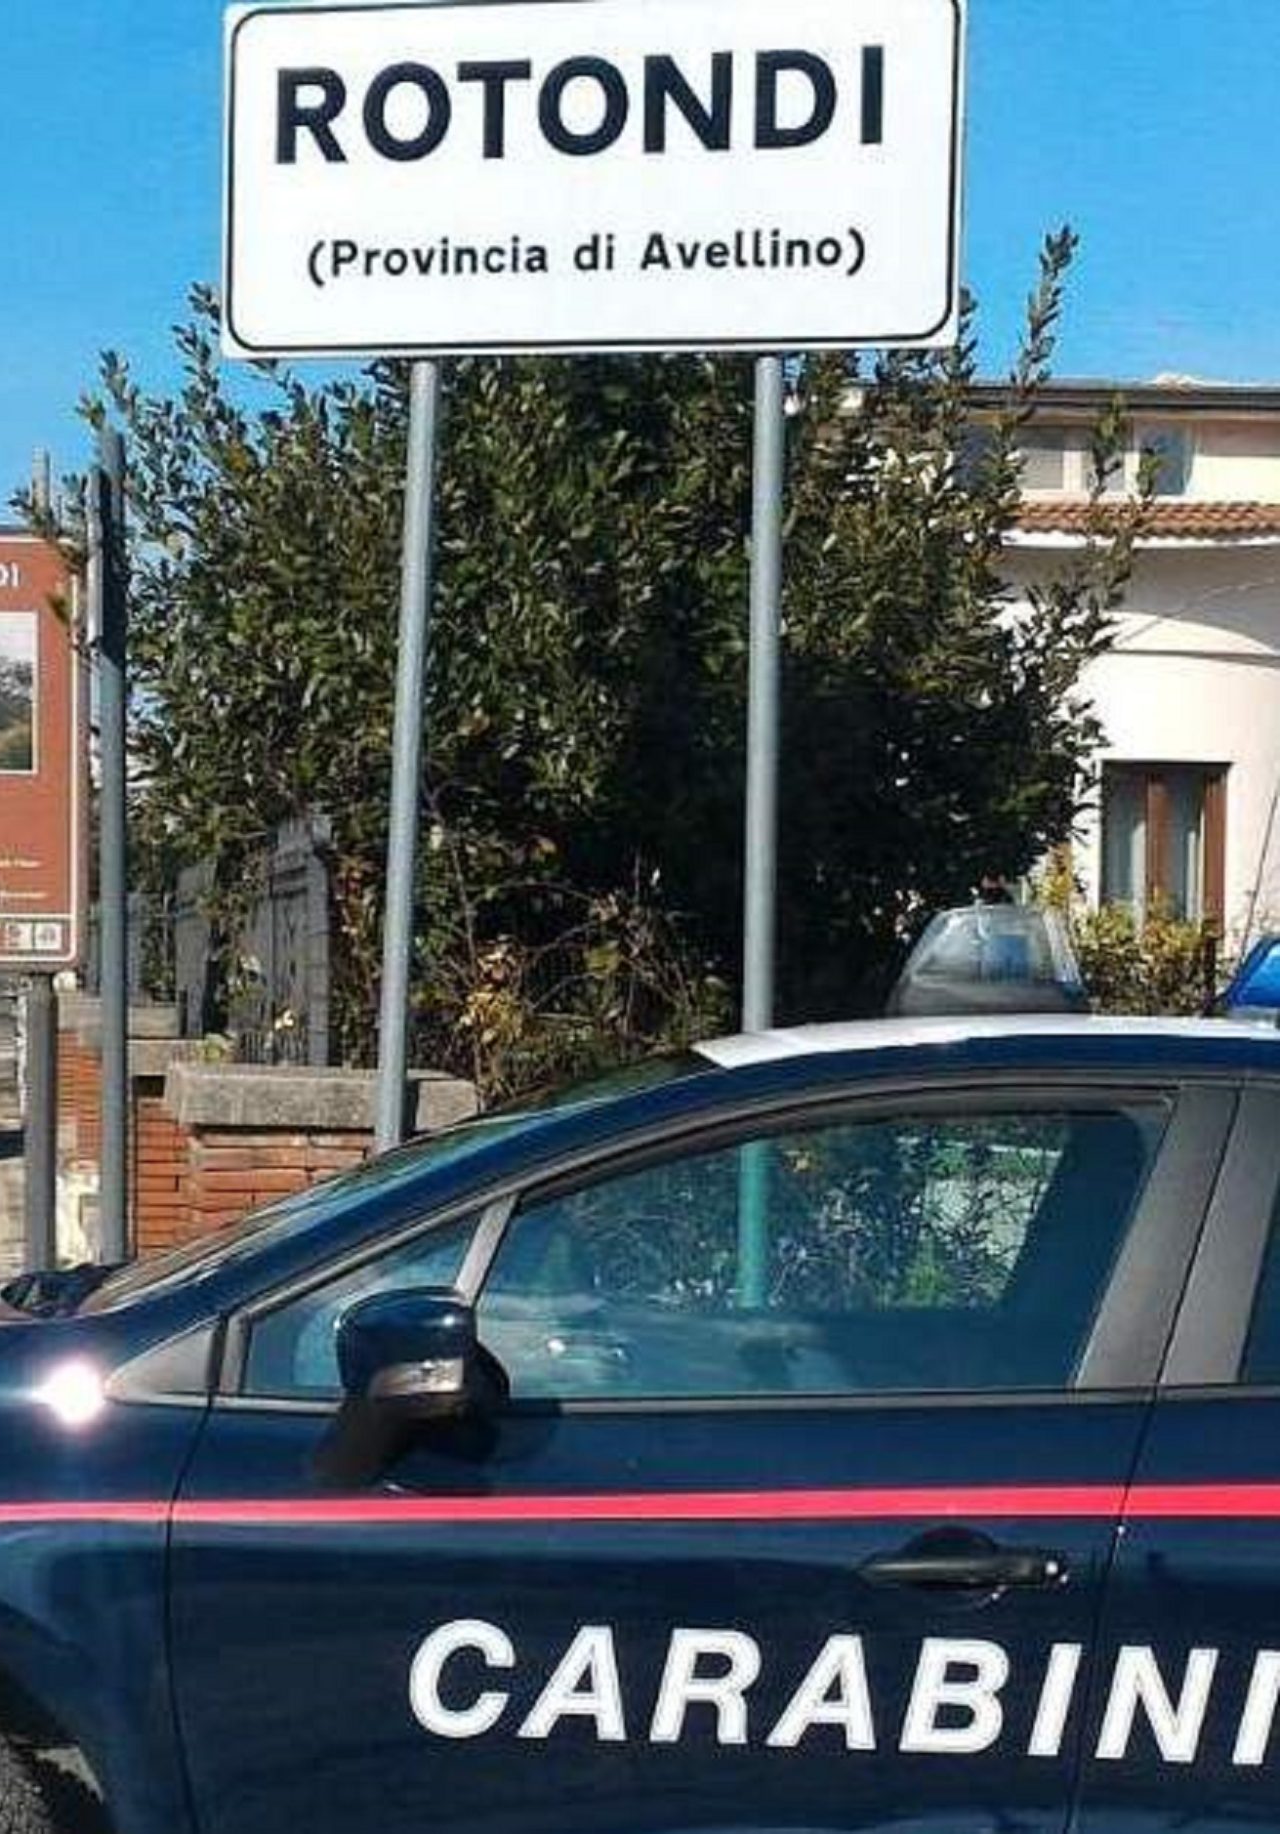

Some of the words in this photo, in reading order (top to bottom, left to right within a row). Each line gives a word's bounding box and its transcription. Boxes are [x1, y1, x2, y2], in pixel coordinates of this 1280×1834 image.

[274, 45, 886, 165] ROTONDI
[308, 234, 548, 288] (Provincia
[574, 232, 615, 272] di
[641, 227, 866, 276] Avellino)
[407, 1618, 1280, 1766] CARABINI
